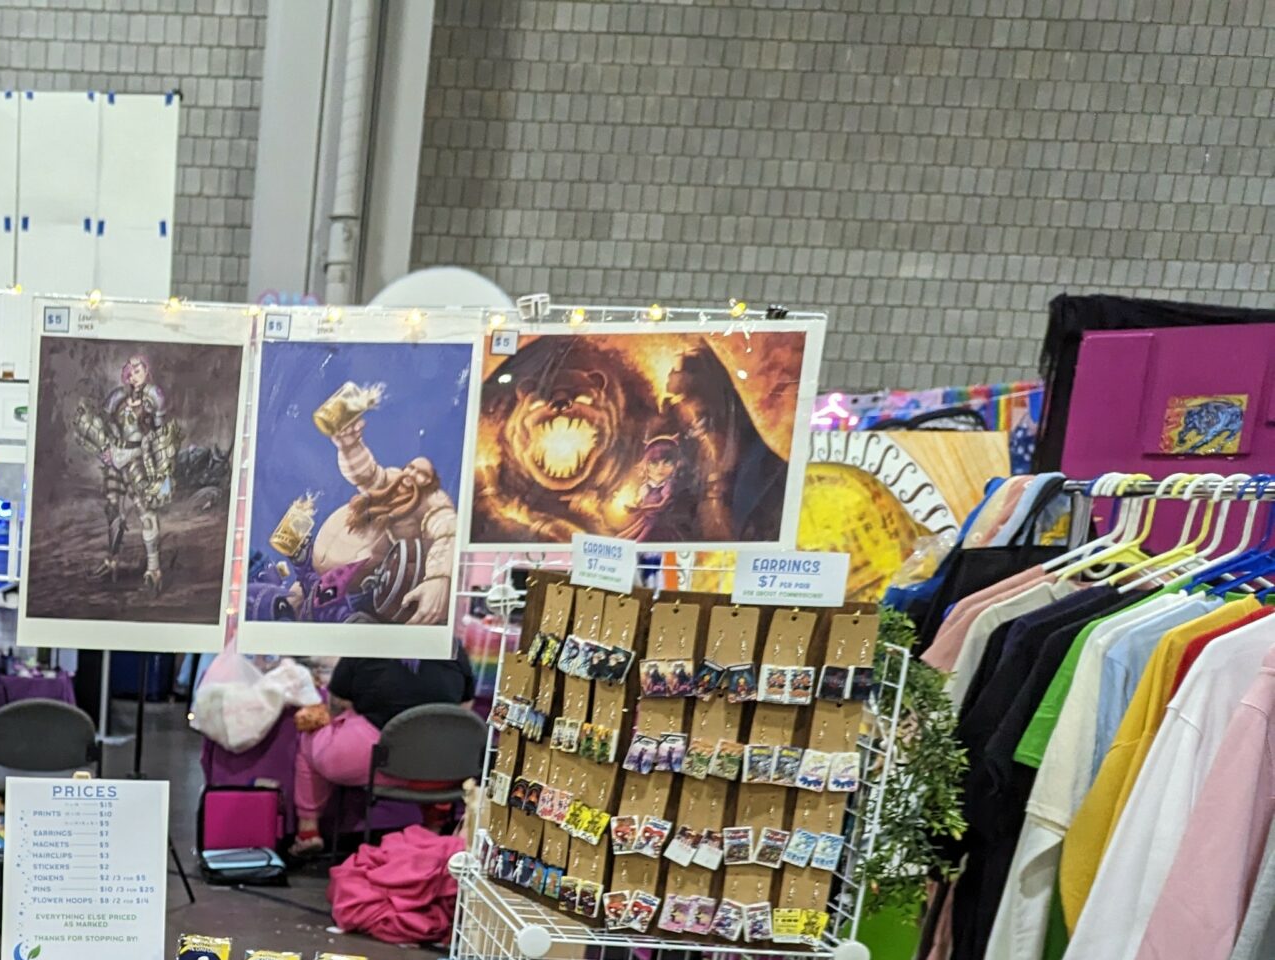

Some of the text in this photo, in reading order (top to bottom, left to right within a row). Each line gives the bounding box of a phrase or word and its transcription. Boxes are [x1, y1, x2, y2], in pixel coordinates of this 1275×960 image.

[47, 314, 61, 324] $5
[268, 321, 282, 331] $5
[495, 336, 510, 348] $5
[587, 558, 599, 570] $7
[751, 558, 821, 573] EARRINGS
[758, 575, 778, 588] $7
[52, 785, 118, 798] PRICES
[33, 810, 61, 818] PRINTS
[99, 810, 113, 818] $10
[32, 852, 73, 860] HAIRCLIPS
[135, 874, 146, 882] $5
